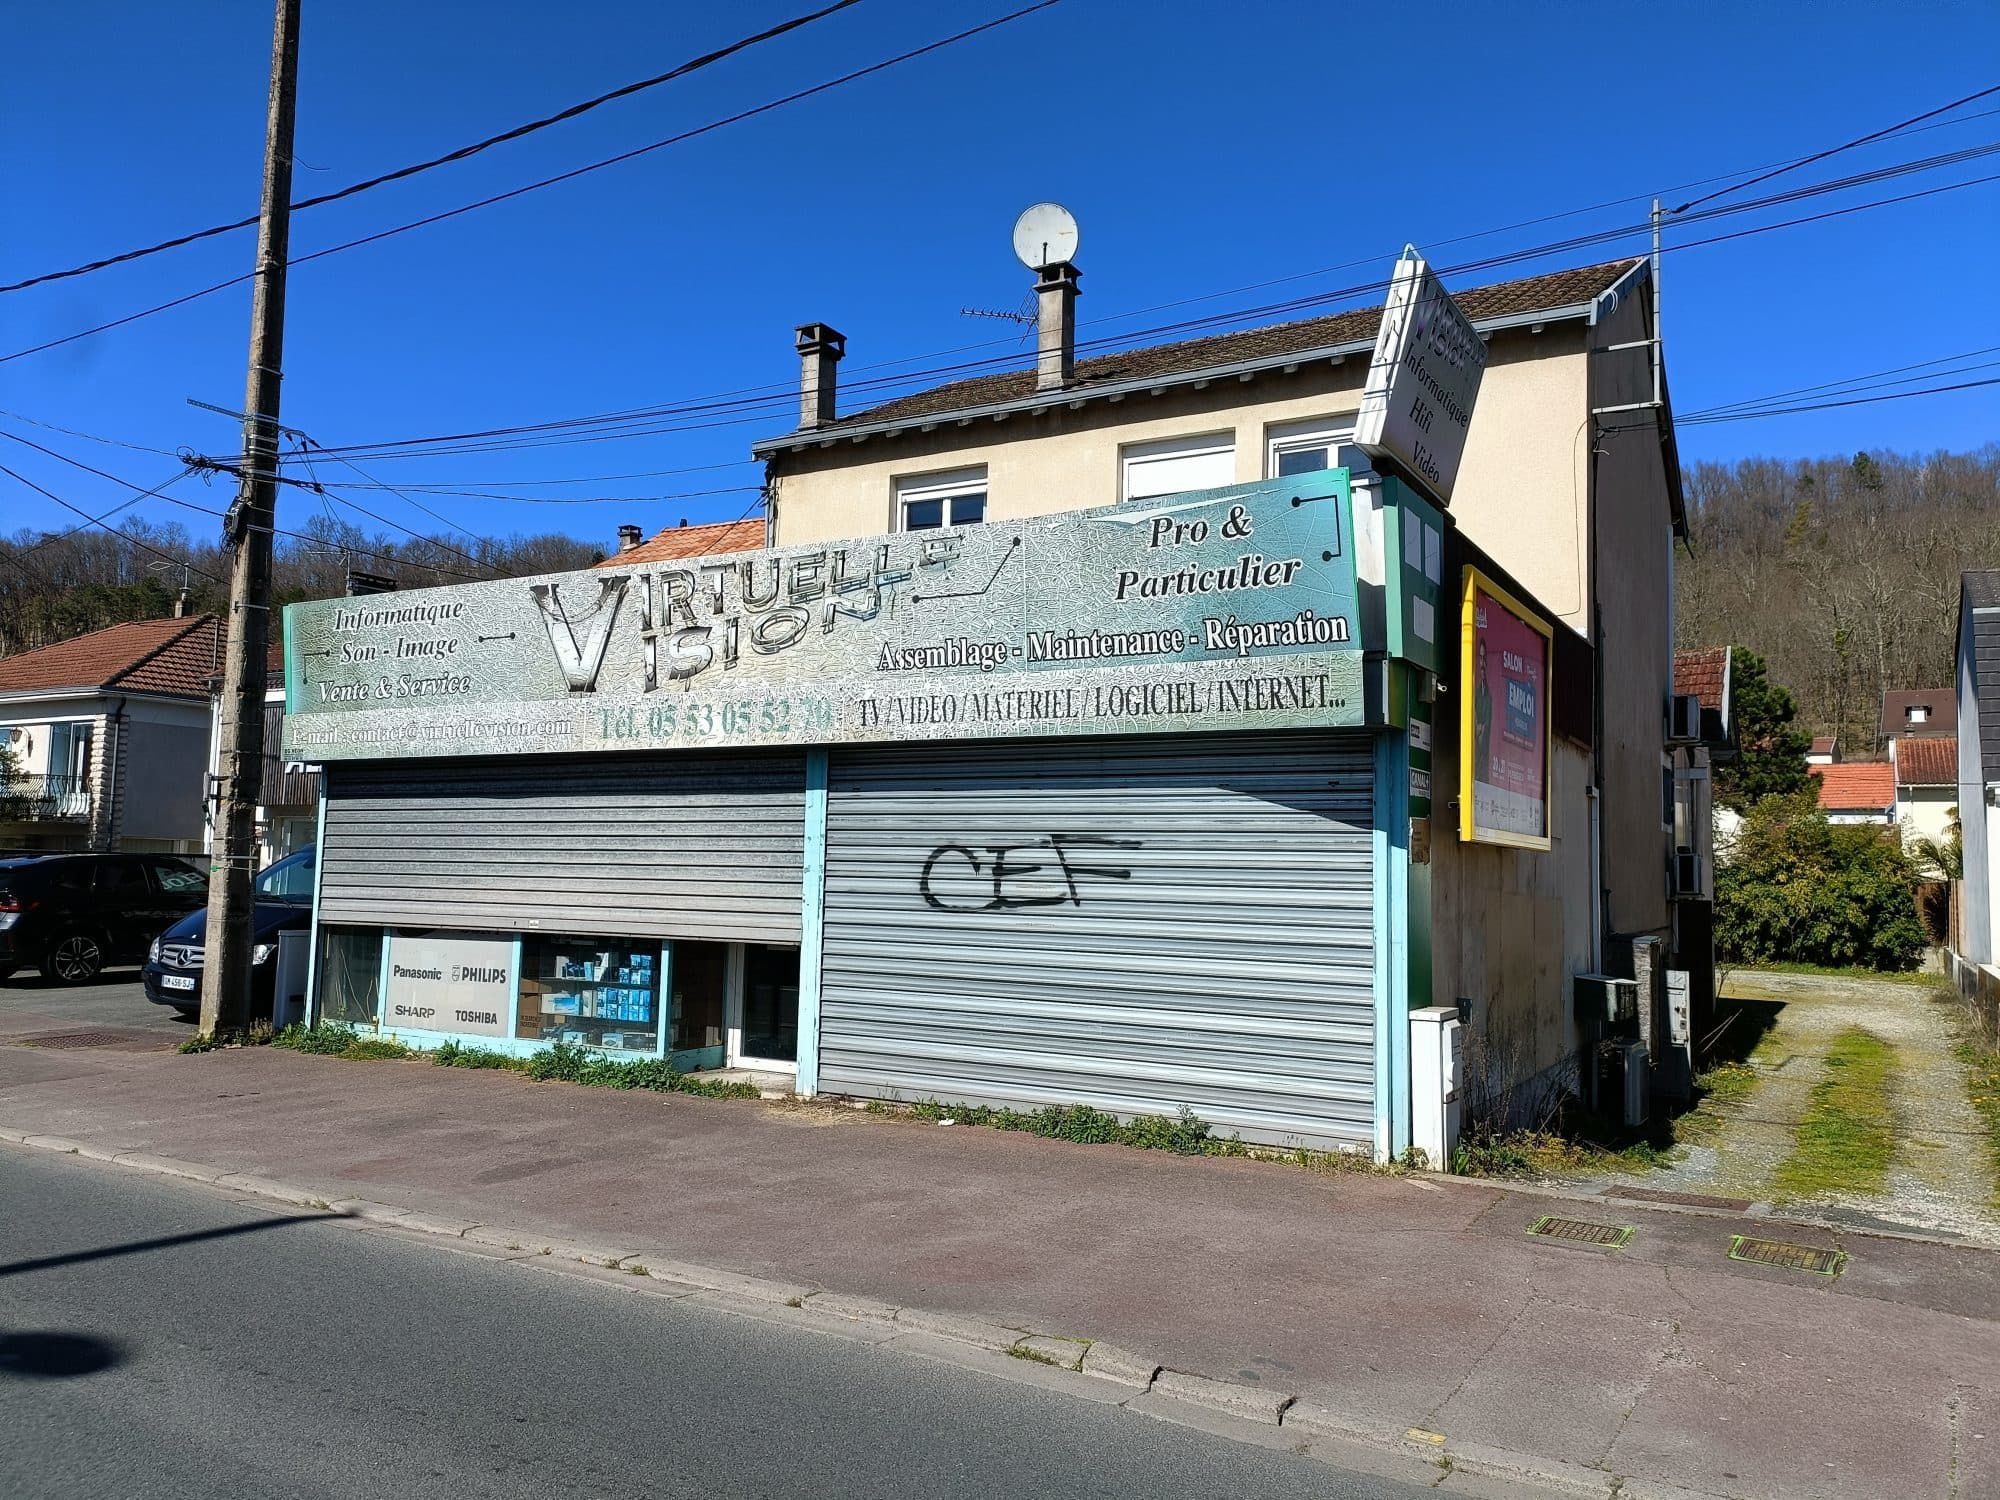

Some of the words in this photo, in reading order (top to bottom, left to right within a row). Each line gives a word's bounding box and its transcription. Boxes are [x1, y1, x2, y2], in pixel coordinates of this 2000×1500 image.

[1404, 342, 1468, 427] Informatique
[1409, 397, 1433, 434] Hifi
[1412, 440, 1440, 483] Vidéo
[1151, 515, 1208, 548] Pro
[1221, 505, 1253, 539] &
[1115, 557, 1301, 601] Particulier
[335, 599, 464, 632] Informatique
[340, 642, 375, 664] Son
[398, 635, 458, 663] Image
[877, 637, 1007, 671] Assemblage
[1027, 624, 1184, 662] Maintenance
[1203, 610, 1349, 656] Réparation
[1504, 651, 1523, 673] SALON
[319, 681, 368, 703] Vente
[374, 677, 392, 699] &
[397, 673, 471, 698] Service
[1095, 682, 1204, 717] LOGICIEL
[1509, 682, 1534, 717] EMPLOI
[649, 704, 677, 737] 05
[685, 703, 713, 736] 53
[722, 701, 750, 735] 05
[760, 699, 790, 733] 52
[292, 727, 338, 746] E-mail
[393, 964, 442, 980] Panasonic
[461, 965, 506, 984] PHILIPS
[395, 1004, 435, 1018] SHARP
[455, 1009, 498, 1025] TOSHIBA
